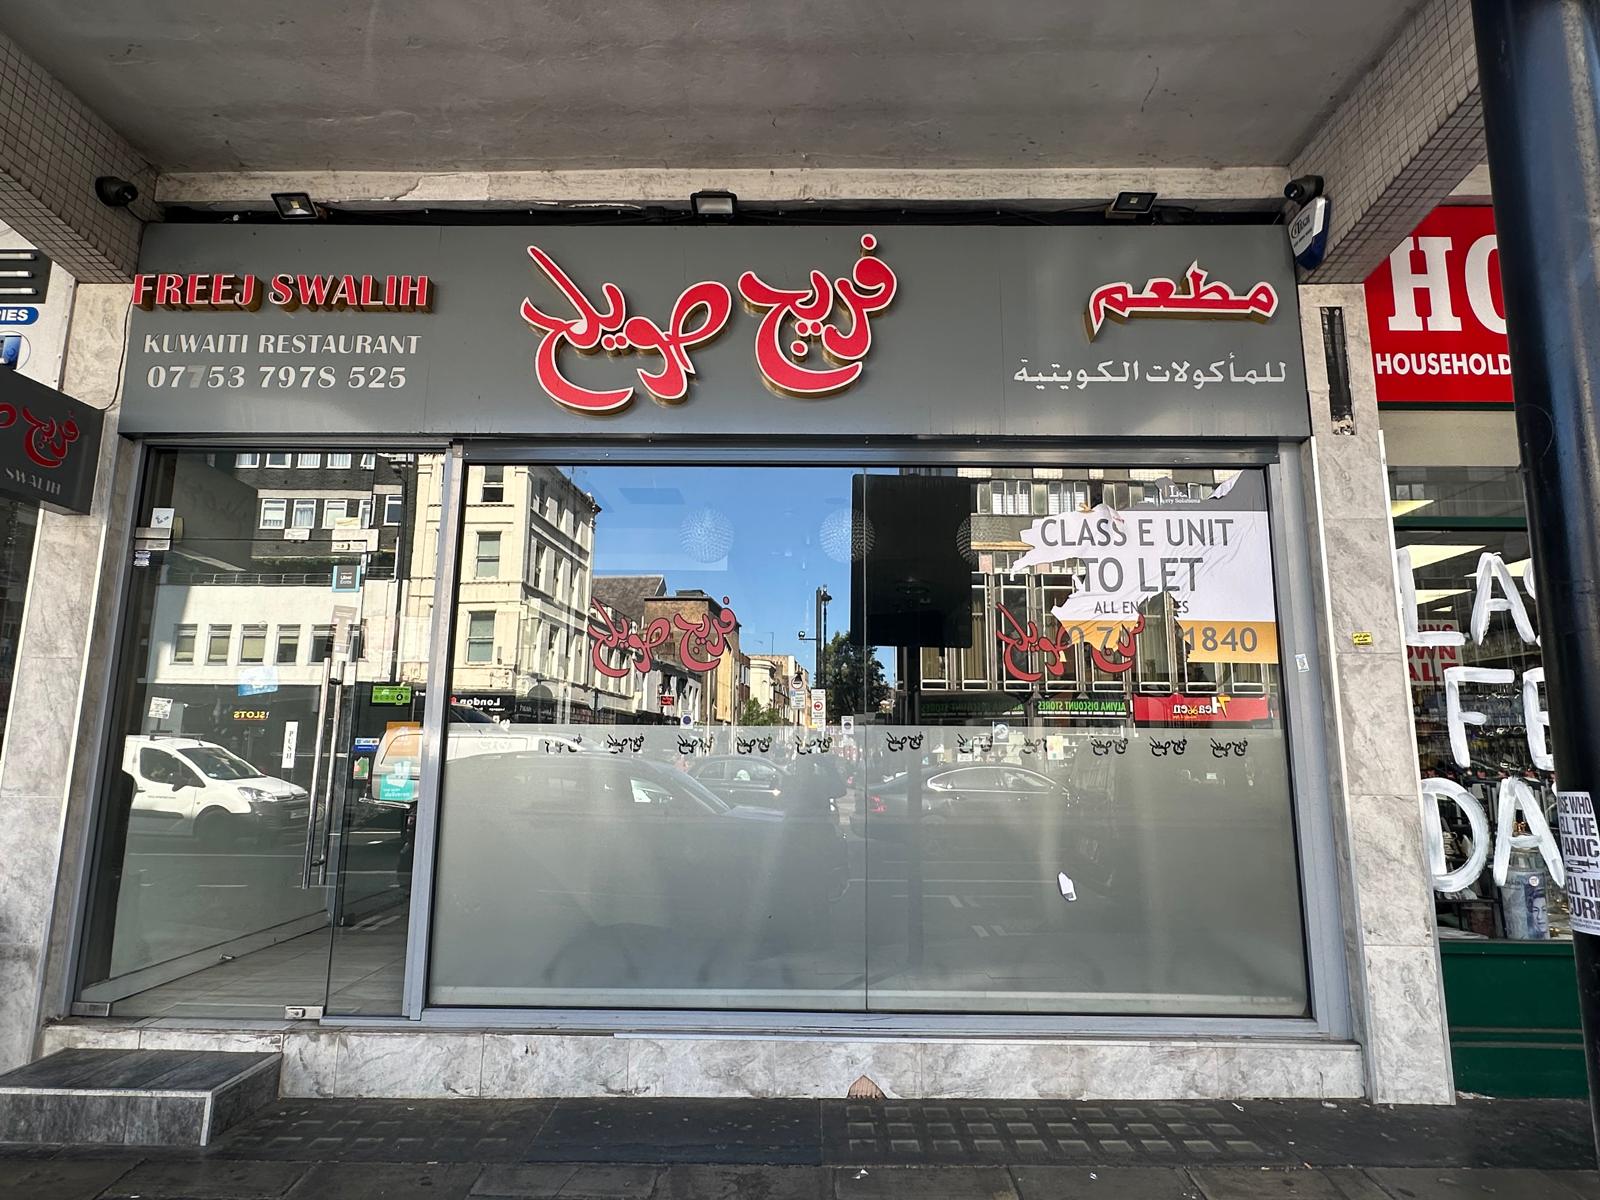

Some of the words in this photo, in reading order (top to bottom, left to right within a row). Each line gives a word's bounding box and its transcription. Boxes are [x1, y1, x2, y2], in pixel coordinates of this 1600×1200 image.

[132, 273, 256, 306] FREEJ
[268, 273, 430, 307] SWALIH
[1087, 258, 1279, 336] مطعم
[0, 309, 29, 321] IES
[520, 245, 732, 411] صويلح
[738, 234, 897, 392] فريج
[143, 333, 249, 354] KUWAITI
[257, 333, 423, 355] RESTAURANT
[258, 365, 337, 389] 7978
[347, 365, 407, 389] 525
[1013, 358, 1139, 390] الكويتية
[1375, 353, 1512, 376] HOUSEHOLD
[1040, 518, 1128, 547] CLASS
[1138, 518, 1155, 546] E
[1165, 518, 1234, 546] UNIT
[1081, 557, 1124, 593] TO
[1138, 557, 1204, 593] LET
[1094, 601, 1118, 614] ALL
[1397, 547, 1541, 648] LA
[673, 596, 737, 673] فريج
[1568, 796, 1593, 815] WHO
[1420, 775, 1566, 893] DA
[1572, 816, 1599, 837] THE
